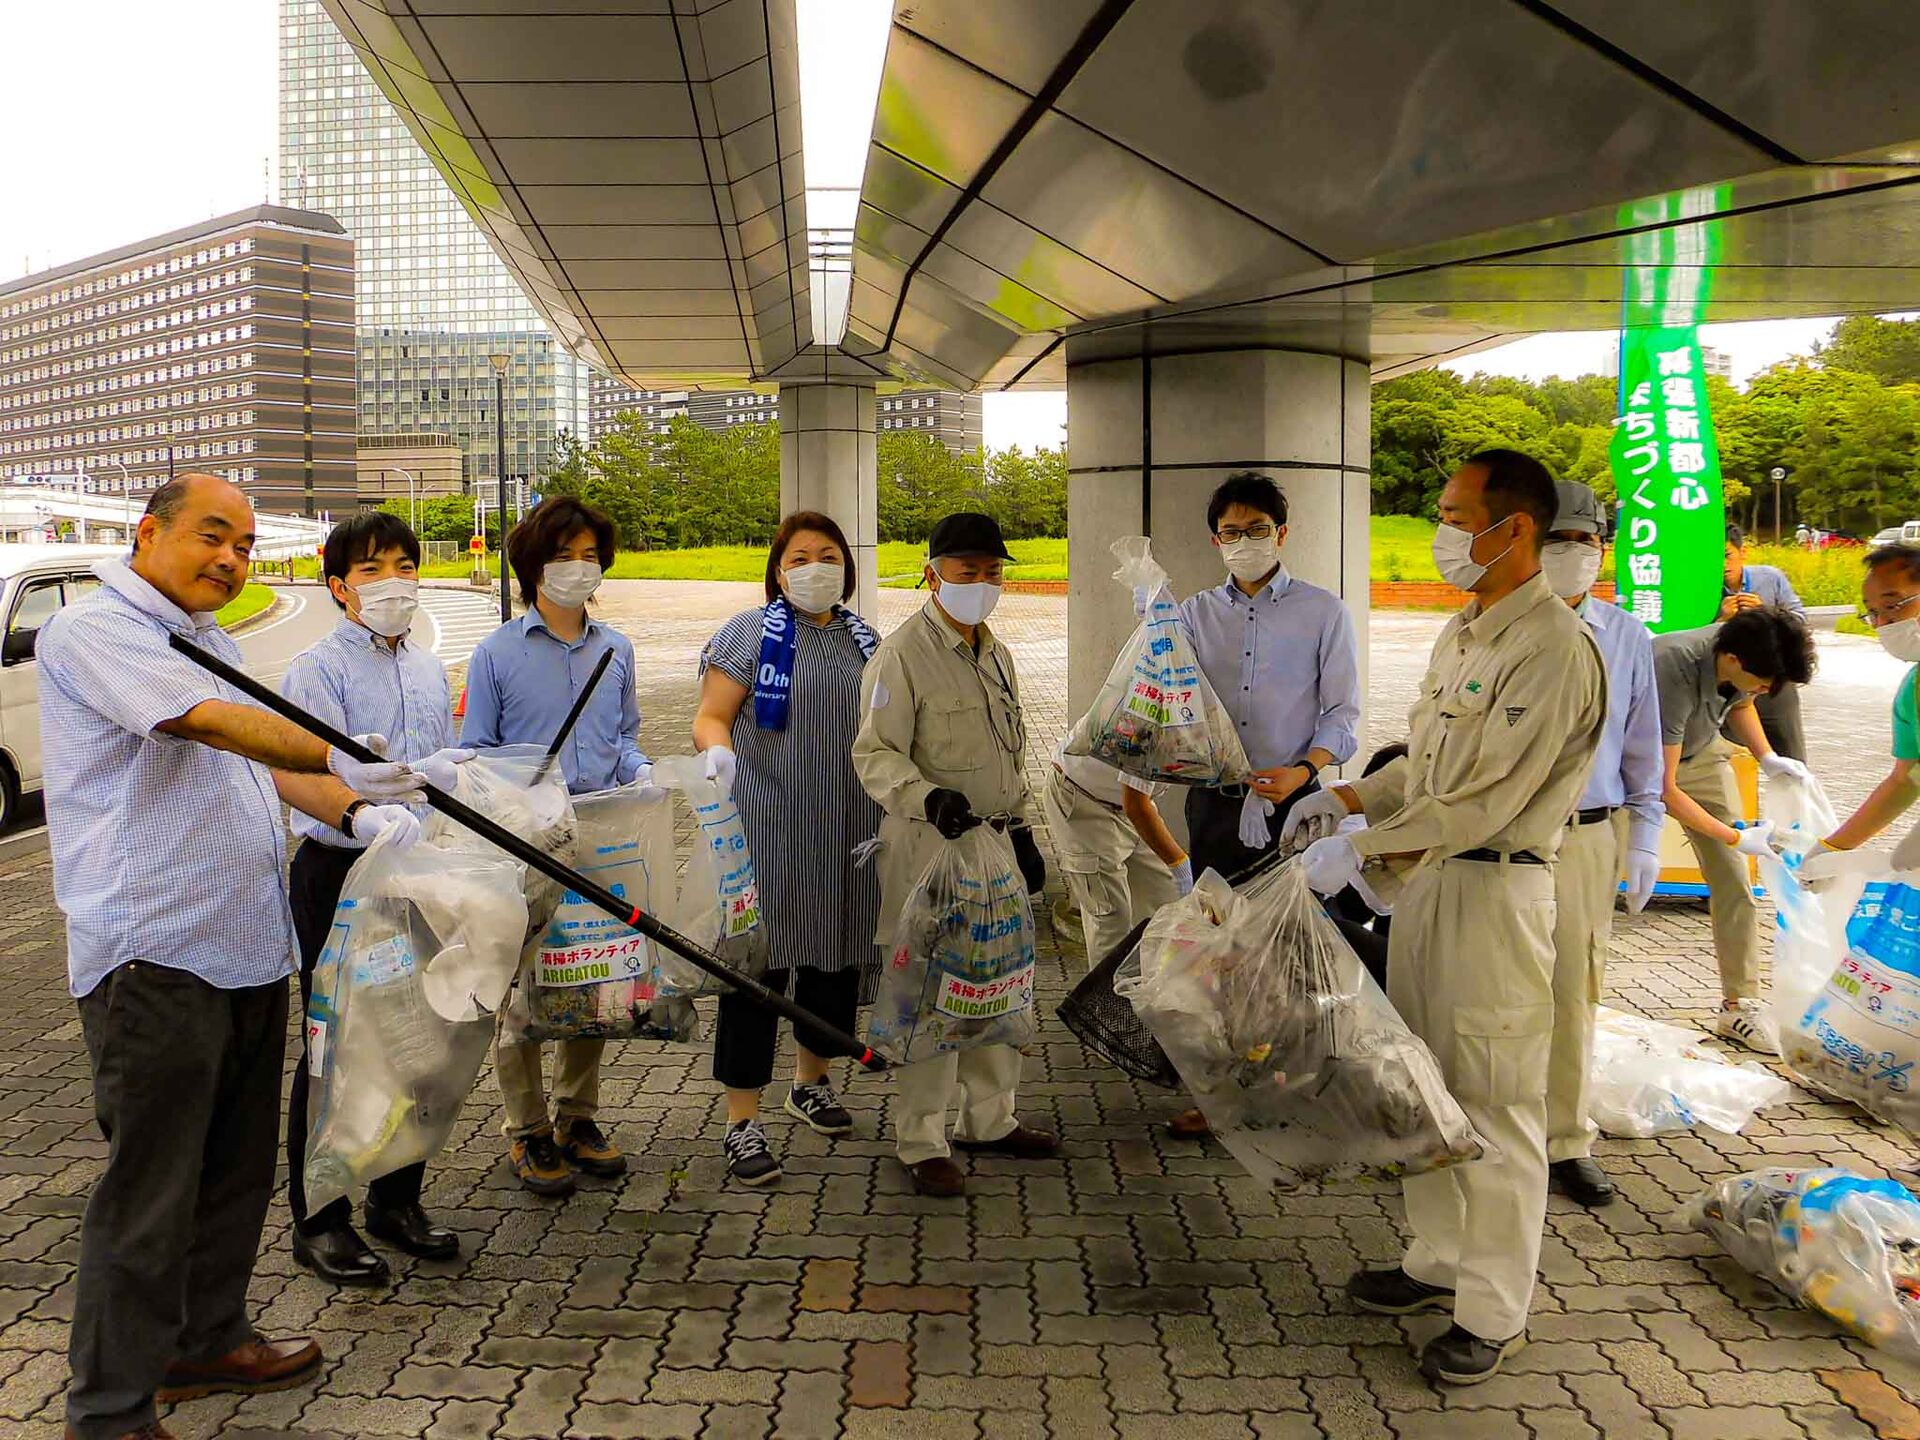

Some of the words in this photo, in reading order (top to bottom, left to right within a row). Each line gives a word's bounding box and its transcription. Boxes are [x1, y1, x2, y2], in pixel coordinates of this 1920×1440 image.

[540, 939, 640, 966] 清掃ボランティア
[542, 962, 611, 984] ARIGATOU
[947, 968, 1033, 1000] 清掃ボランティア
[943, 995, 1009, 1017] ARIGATOU
